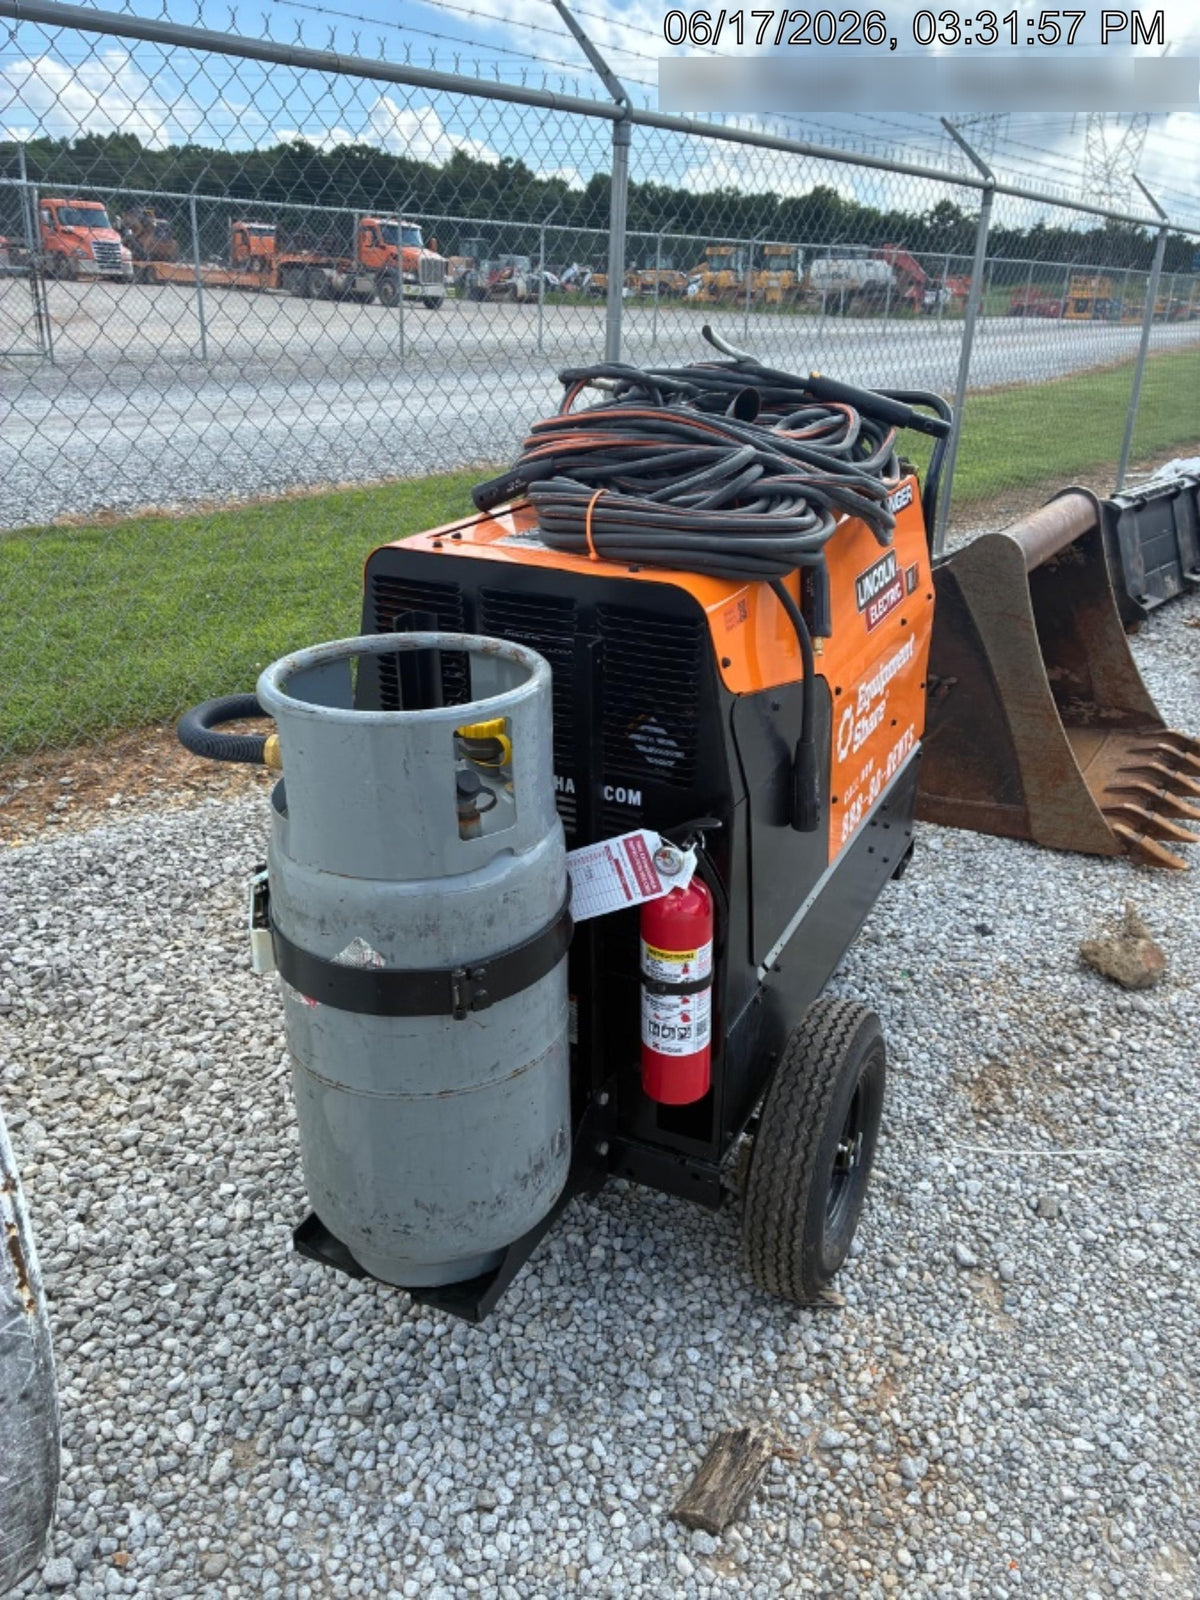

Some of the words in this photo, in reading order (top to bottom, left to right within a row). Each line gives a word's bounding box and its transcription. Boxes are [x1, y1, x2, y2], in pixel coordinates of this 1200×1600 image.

[887, 483, 913, 513] NGER
[857, 555, 897, 607] LINCOLN
[869, 582, 903, 625] ELECTRIC
[856, 632, 916, 717] Equipment
[852, 699, 886, 754] Share
